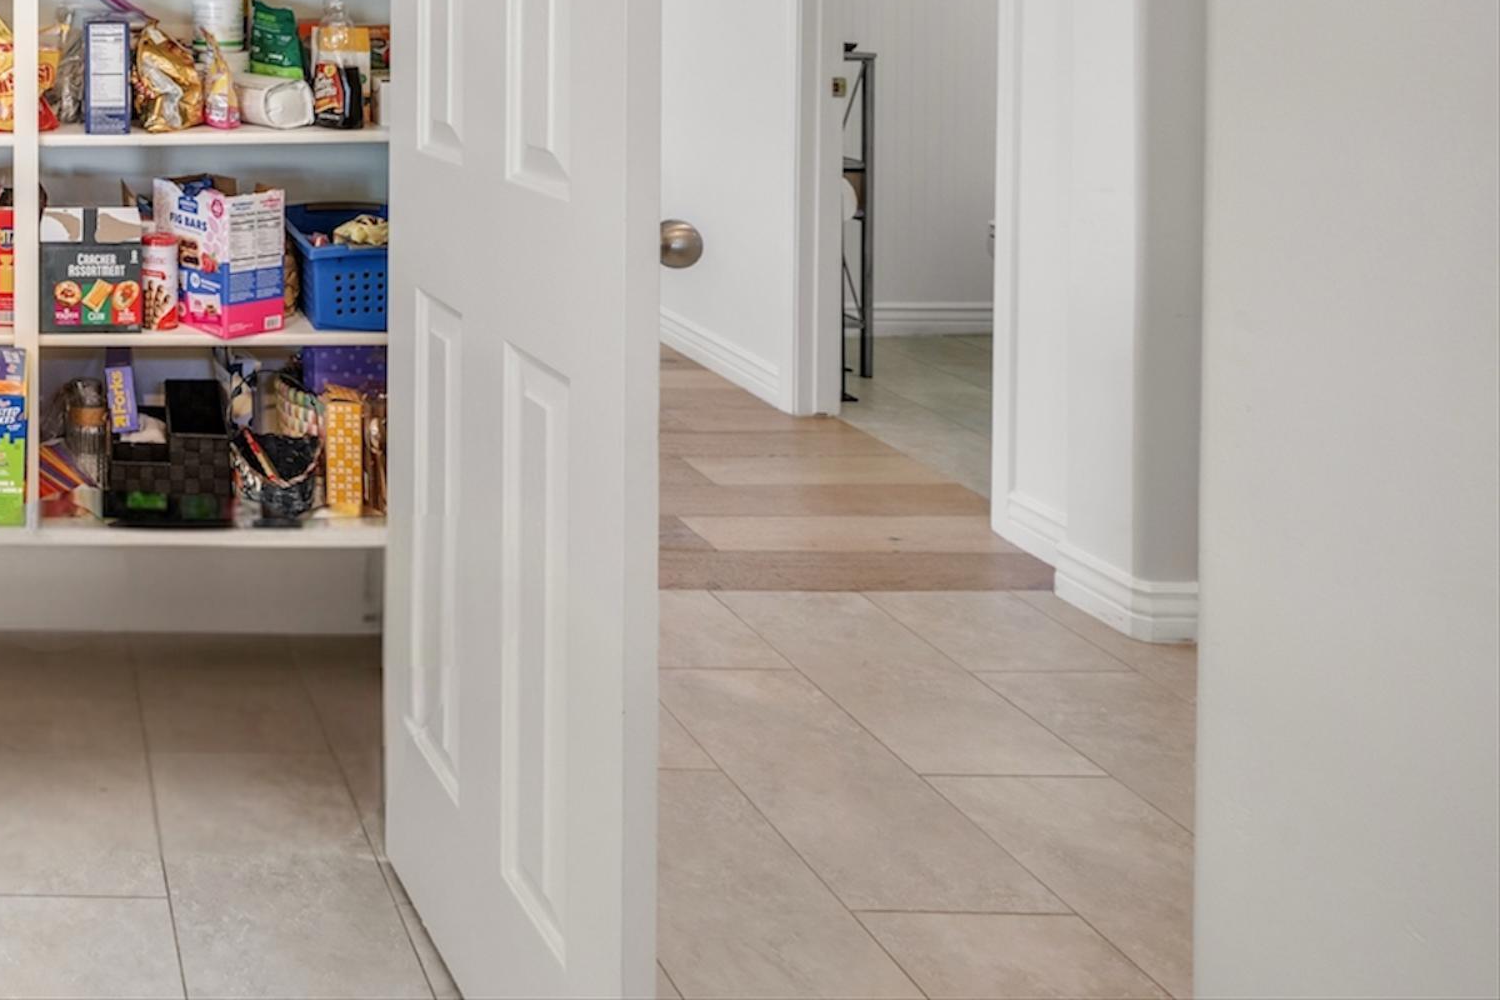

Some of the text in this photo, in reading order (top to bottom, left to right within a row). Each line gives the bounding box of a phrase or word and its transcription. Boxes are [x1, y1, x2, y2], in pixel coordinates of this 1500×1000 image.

[170, 211, 208, 232] FIG BARS
[77, 252, 117, 266] CRACKER
[68, 264, 126, 278] ASSORTMENT
[109, 370, 127, 415] Forks
